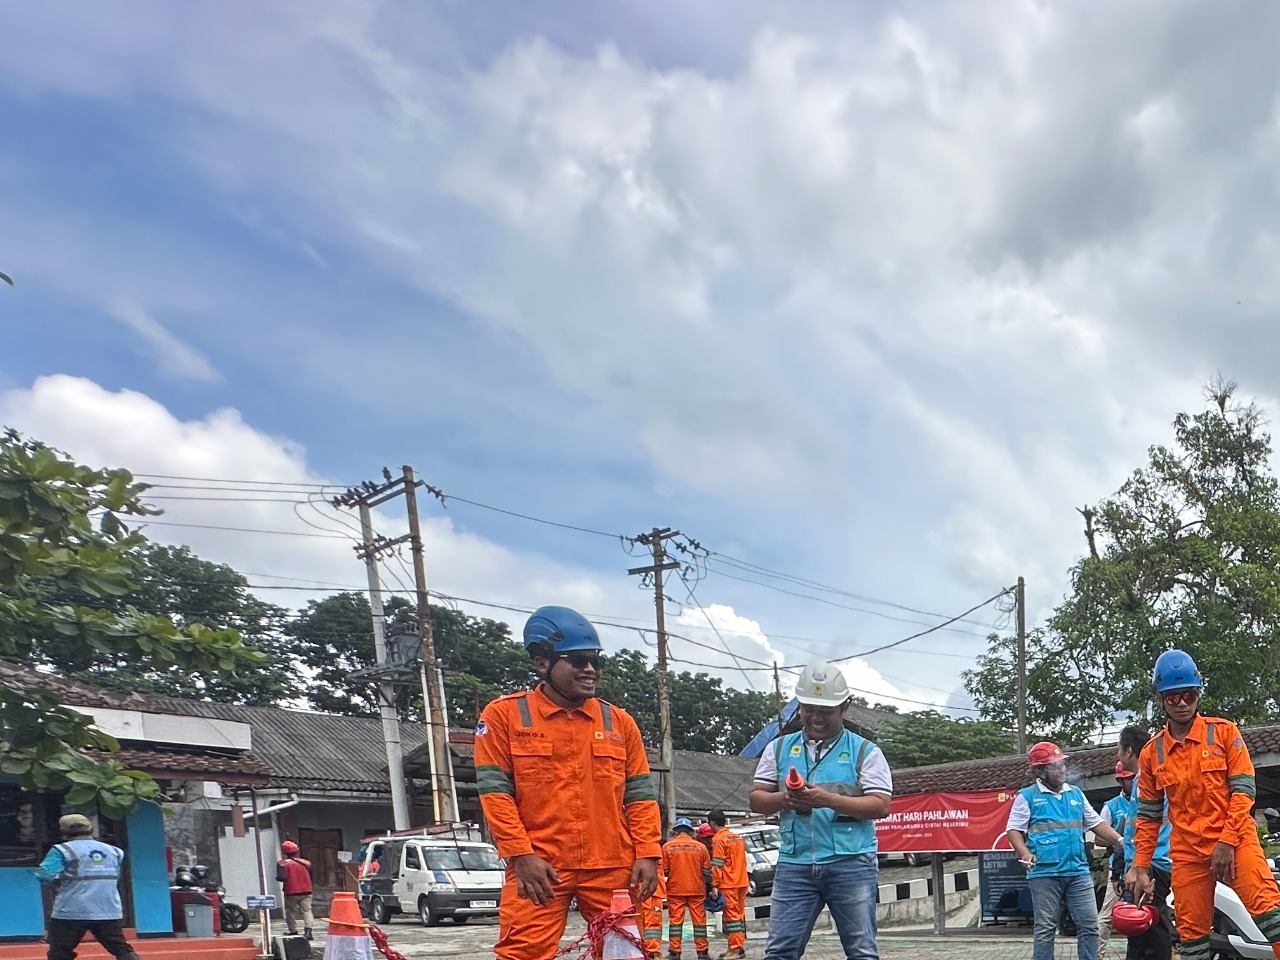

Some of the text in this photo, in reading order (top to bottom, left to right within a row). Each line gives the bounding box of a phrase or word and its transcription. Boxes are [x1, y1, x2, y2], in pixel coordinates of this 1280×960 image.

[903, 811, 923, 822] HARI
[923, 809, 969, 821] PAHLAWAN
[983, 853, 1019, 861] KENDARAA
